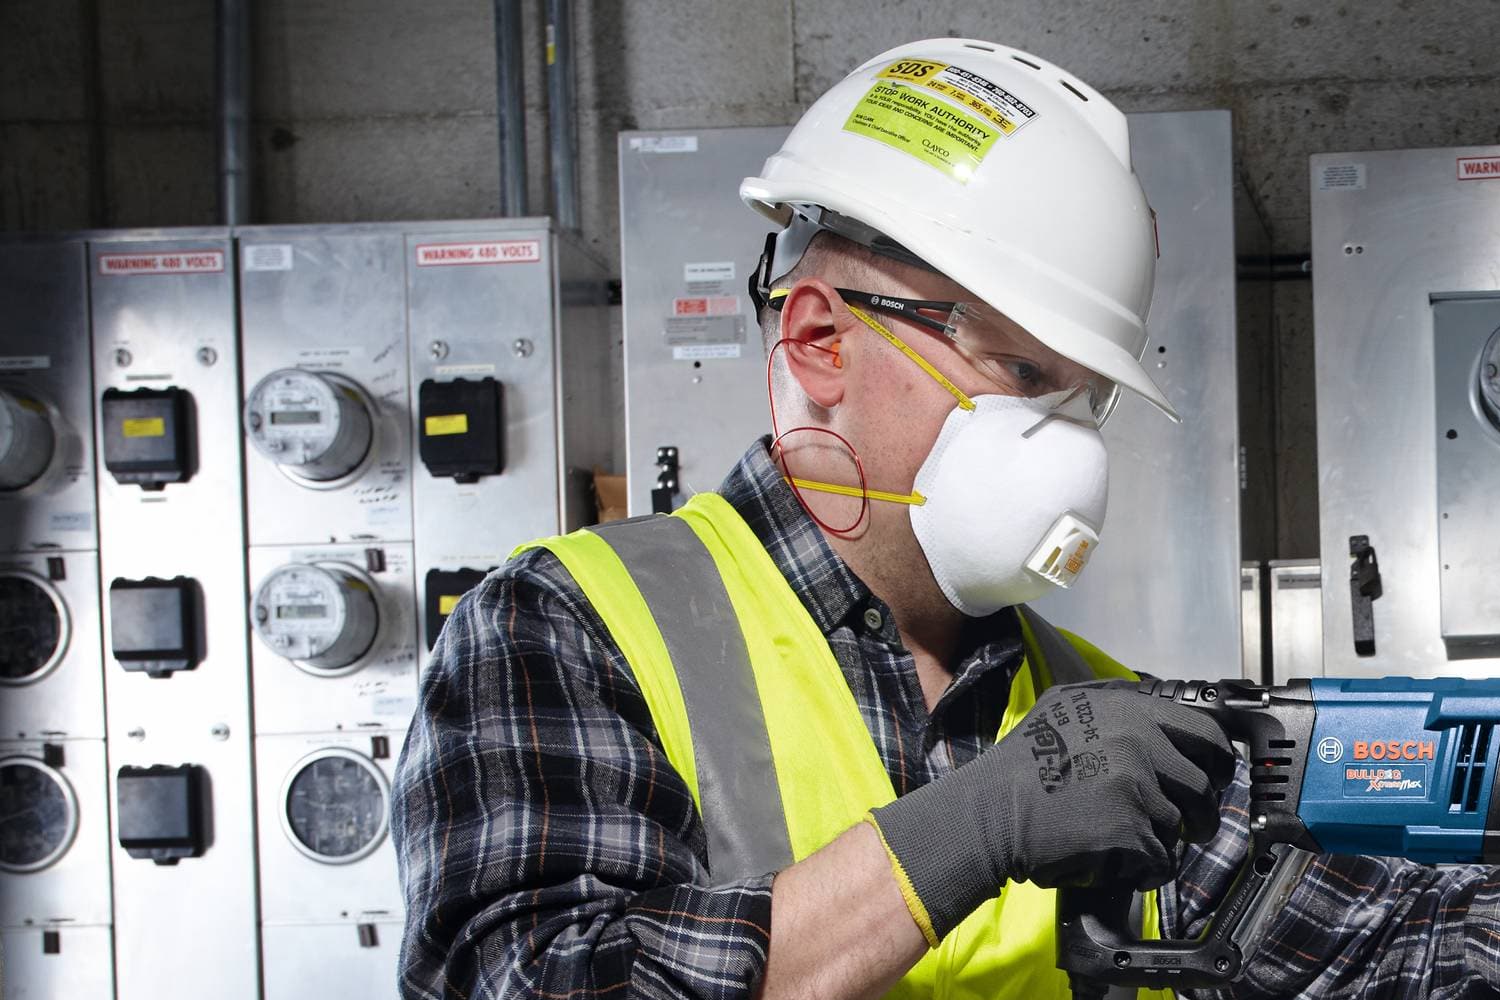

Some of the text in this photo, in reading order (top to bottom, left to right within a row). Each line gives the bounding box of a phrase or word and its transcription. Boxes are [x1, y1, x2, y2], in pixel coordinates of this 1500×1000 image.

[890, 62, 934, 77] SDS
[874, 86, 899, 96] STOP
[900, 92, 931, 109] WORK
[930, 106, 990, 139] AUTHORITY
[922, 139, 950, 157] CLAYCO
[423, 245, 533, 260] WARNING 480 VOLTS
[107, 257, 157, 269] WARNING
[186, 256, 217, 267] VOLTS
[881, 299, 905, 310] BOSCH
[1049, 702, 1070, 726] BFN
[1353, 740, 1434, 760] BOSCH
